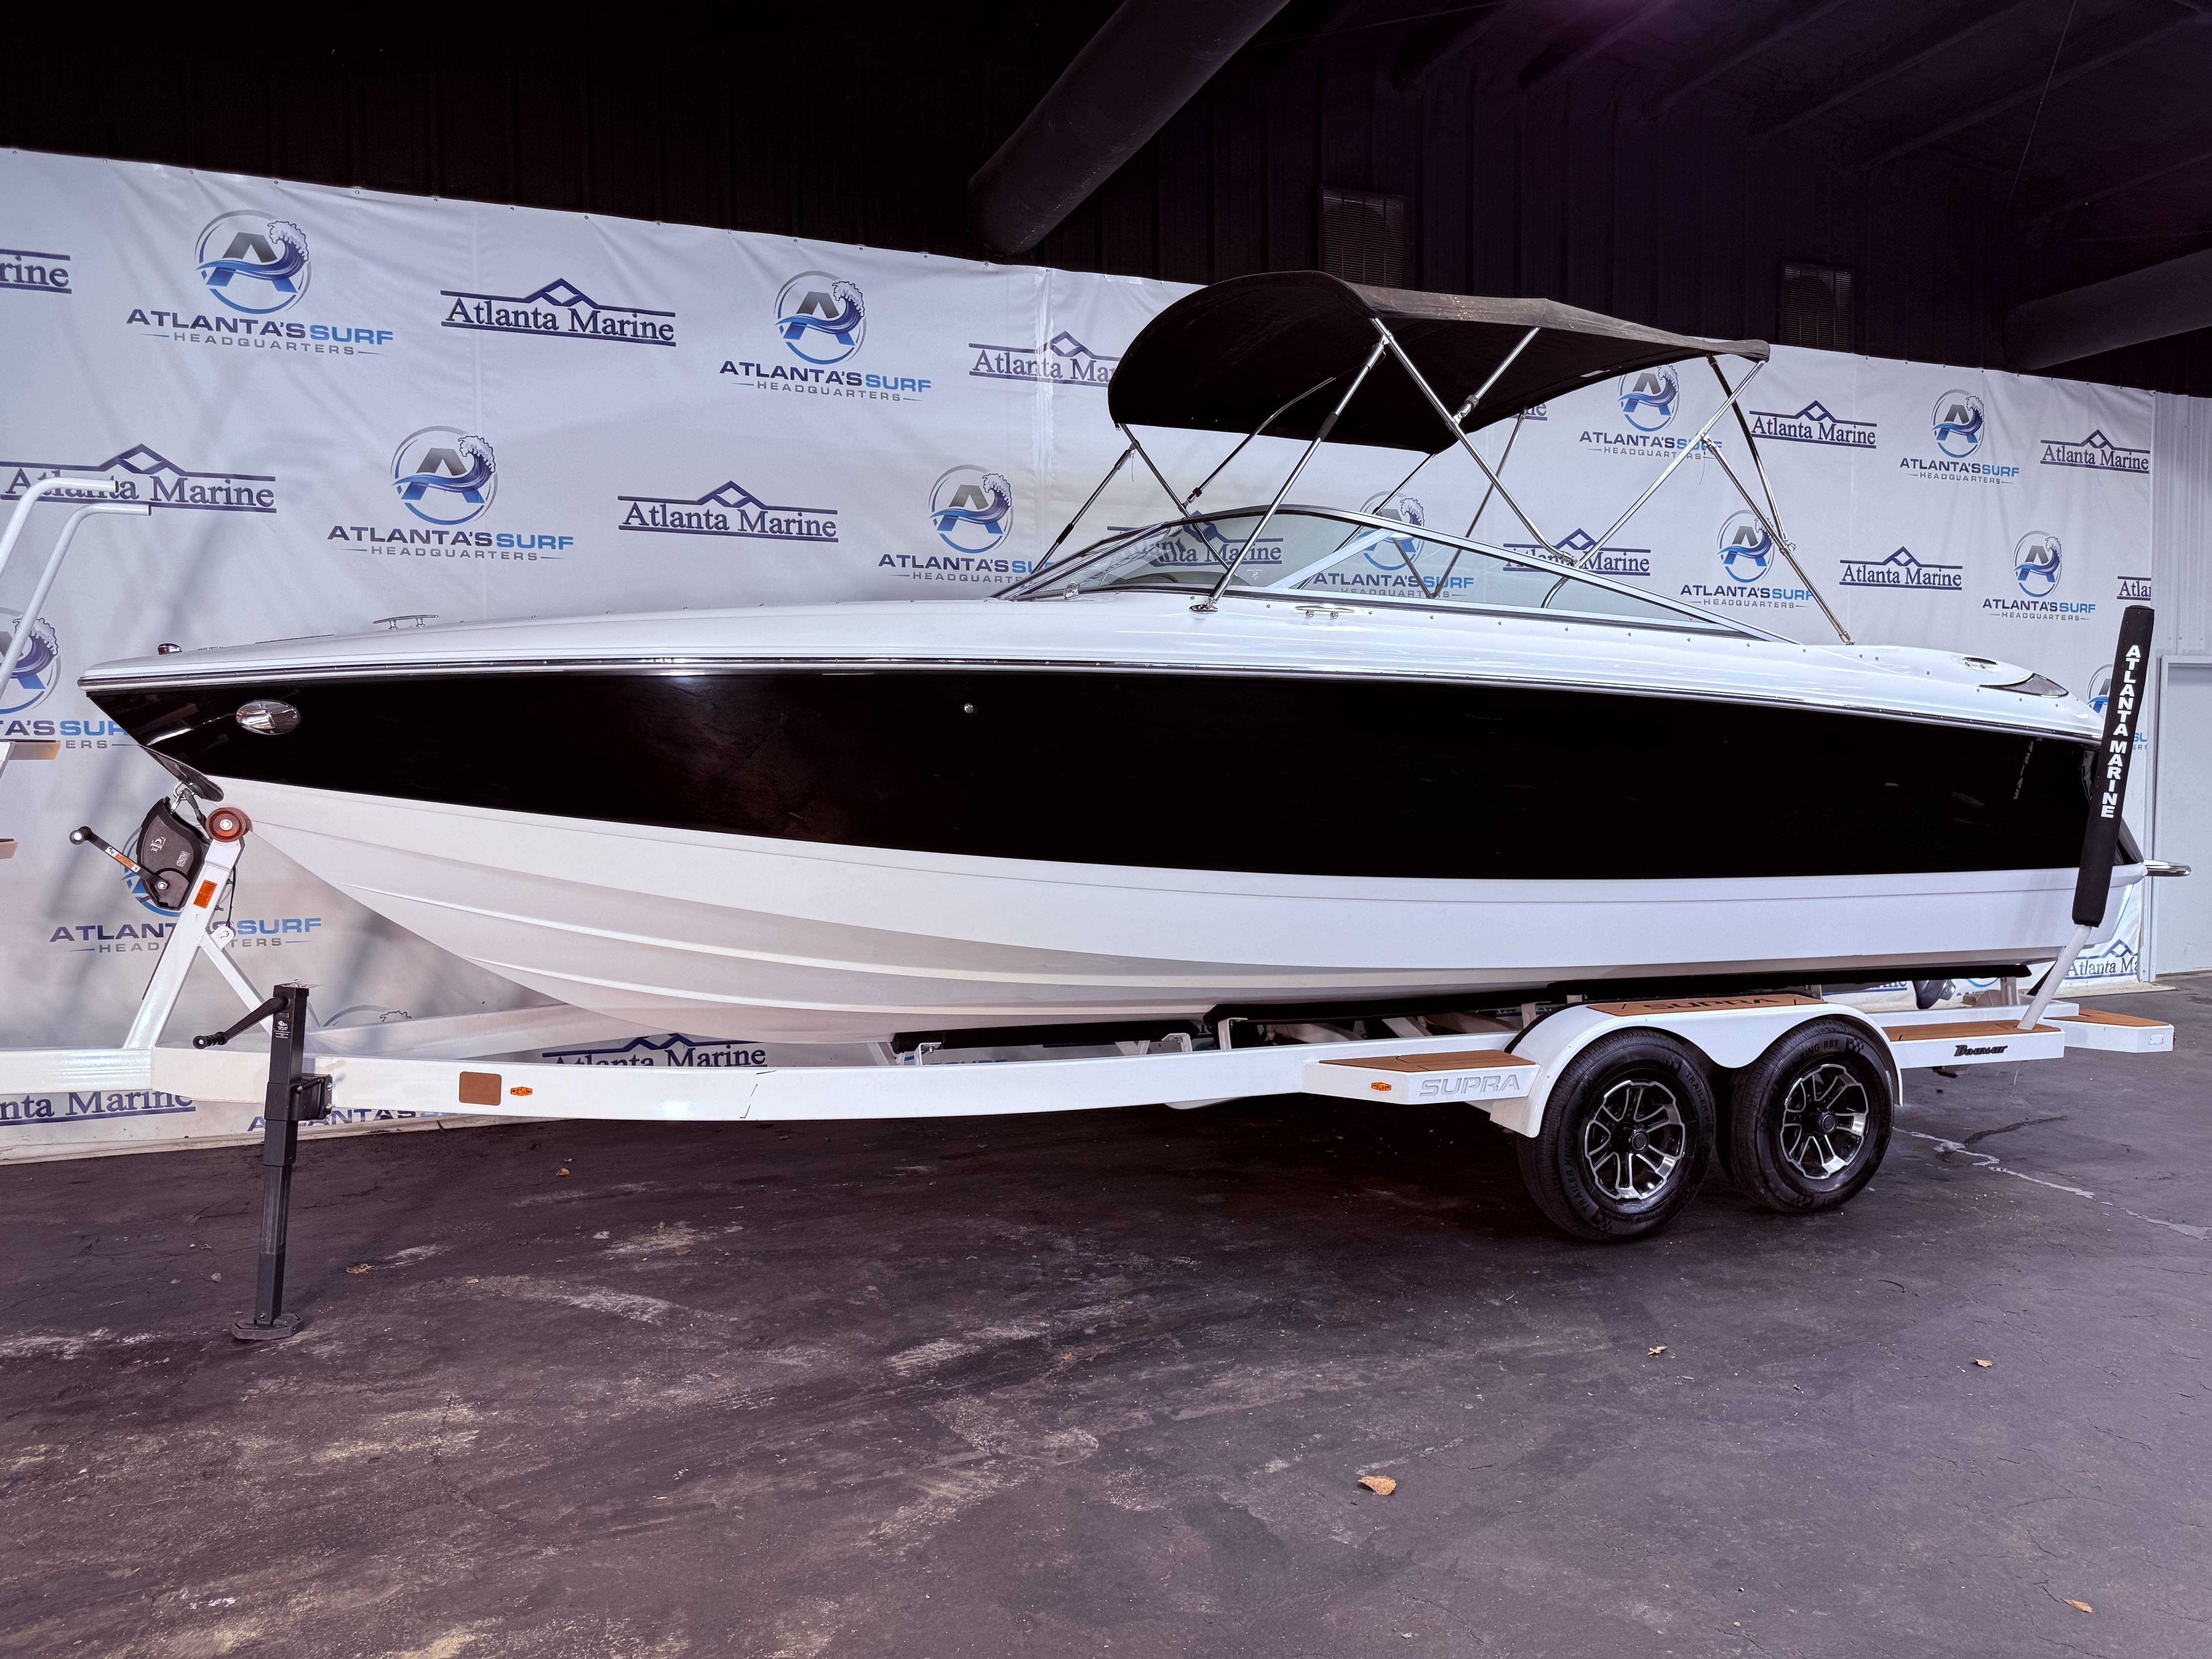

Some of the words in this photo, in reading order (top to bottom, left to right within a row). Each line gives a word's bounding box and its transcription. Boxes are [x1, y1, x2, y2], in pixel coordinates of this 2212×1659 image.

[127, 309, 306, 339] ATLANTA'S
[310, 325, 393, 345] SURF
[445, 297, 559, 331] Atlanta
[568, 308, 675, 342] Marine
[174, 332, 354, 356] HEADQUARTERS
[972, 348, 1063, 379] Atlanta
[720, 361, 862, 386] ATLANTA'S
[866, 374, 931, 393] SURF
[757, 381, 901, 402] HEADQUARTERS
[1580, 431, 1674, 448] ATLANTA'S
[1752, 415, 1813, 441] Atlanta
[1817, 423, 1876, 445] Marine
[1604, 447, 1701, 460] HEADQUARTRS
[2042, 444, 2095, 465] Atlanta
[2099, 449, 2149, 471] Marine
[1900, 458, 1981, 475] ATLANTA'S
[1982, 465, 2019, 477] SURF
[1920, 472, 2001, 485] HEADQUARTERS
[149, 476, 274, 507] Marine
[622, 501, 729, 531] Atlanta
[737, 509, 836, 537] Marine
[327, 526, 492, 546] ATLANTA'S
[496, 534, 574, 550] SURF
[371, 546, 537, 561] HEADQUARTERS
[878, 554, 1009, 572] ATLANTA'S
[1204, 543, 1281, 562] Maine
[913, 572, 1022, 584] HEADQUARTE
[1313, 572, 1420, 587] ATLANTA'S
[1842, 564, 1900, 585] Atlanta
[1905, 567, 1961, 587] Marine
[1680, 585, 1770, 598] ATLANTA'S
[1704, 598, 1794, 608] HEADQUARTERS
[1982, 598, 2058, 612] ATLANTA'S
[2060, 602, 2096, 614] SURF
[2002, 611, 2079, 622] HEADQUARTERS
[2113, 645, 2141, 737] ATLANTA
[60, 720, 130, 736] SUR
[2101, 741, 2126, 818] MARINE
[237, 918, 321, 934] SURF
[1823, 1039, 1839, 1048] RST
[664, 1045, 766, 1067] Marine
[1420, 1075, 1520, 1096] SUPRA
[1567, 1170, 1589, 1211] TRAILER
